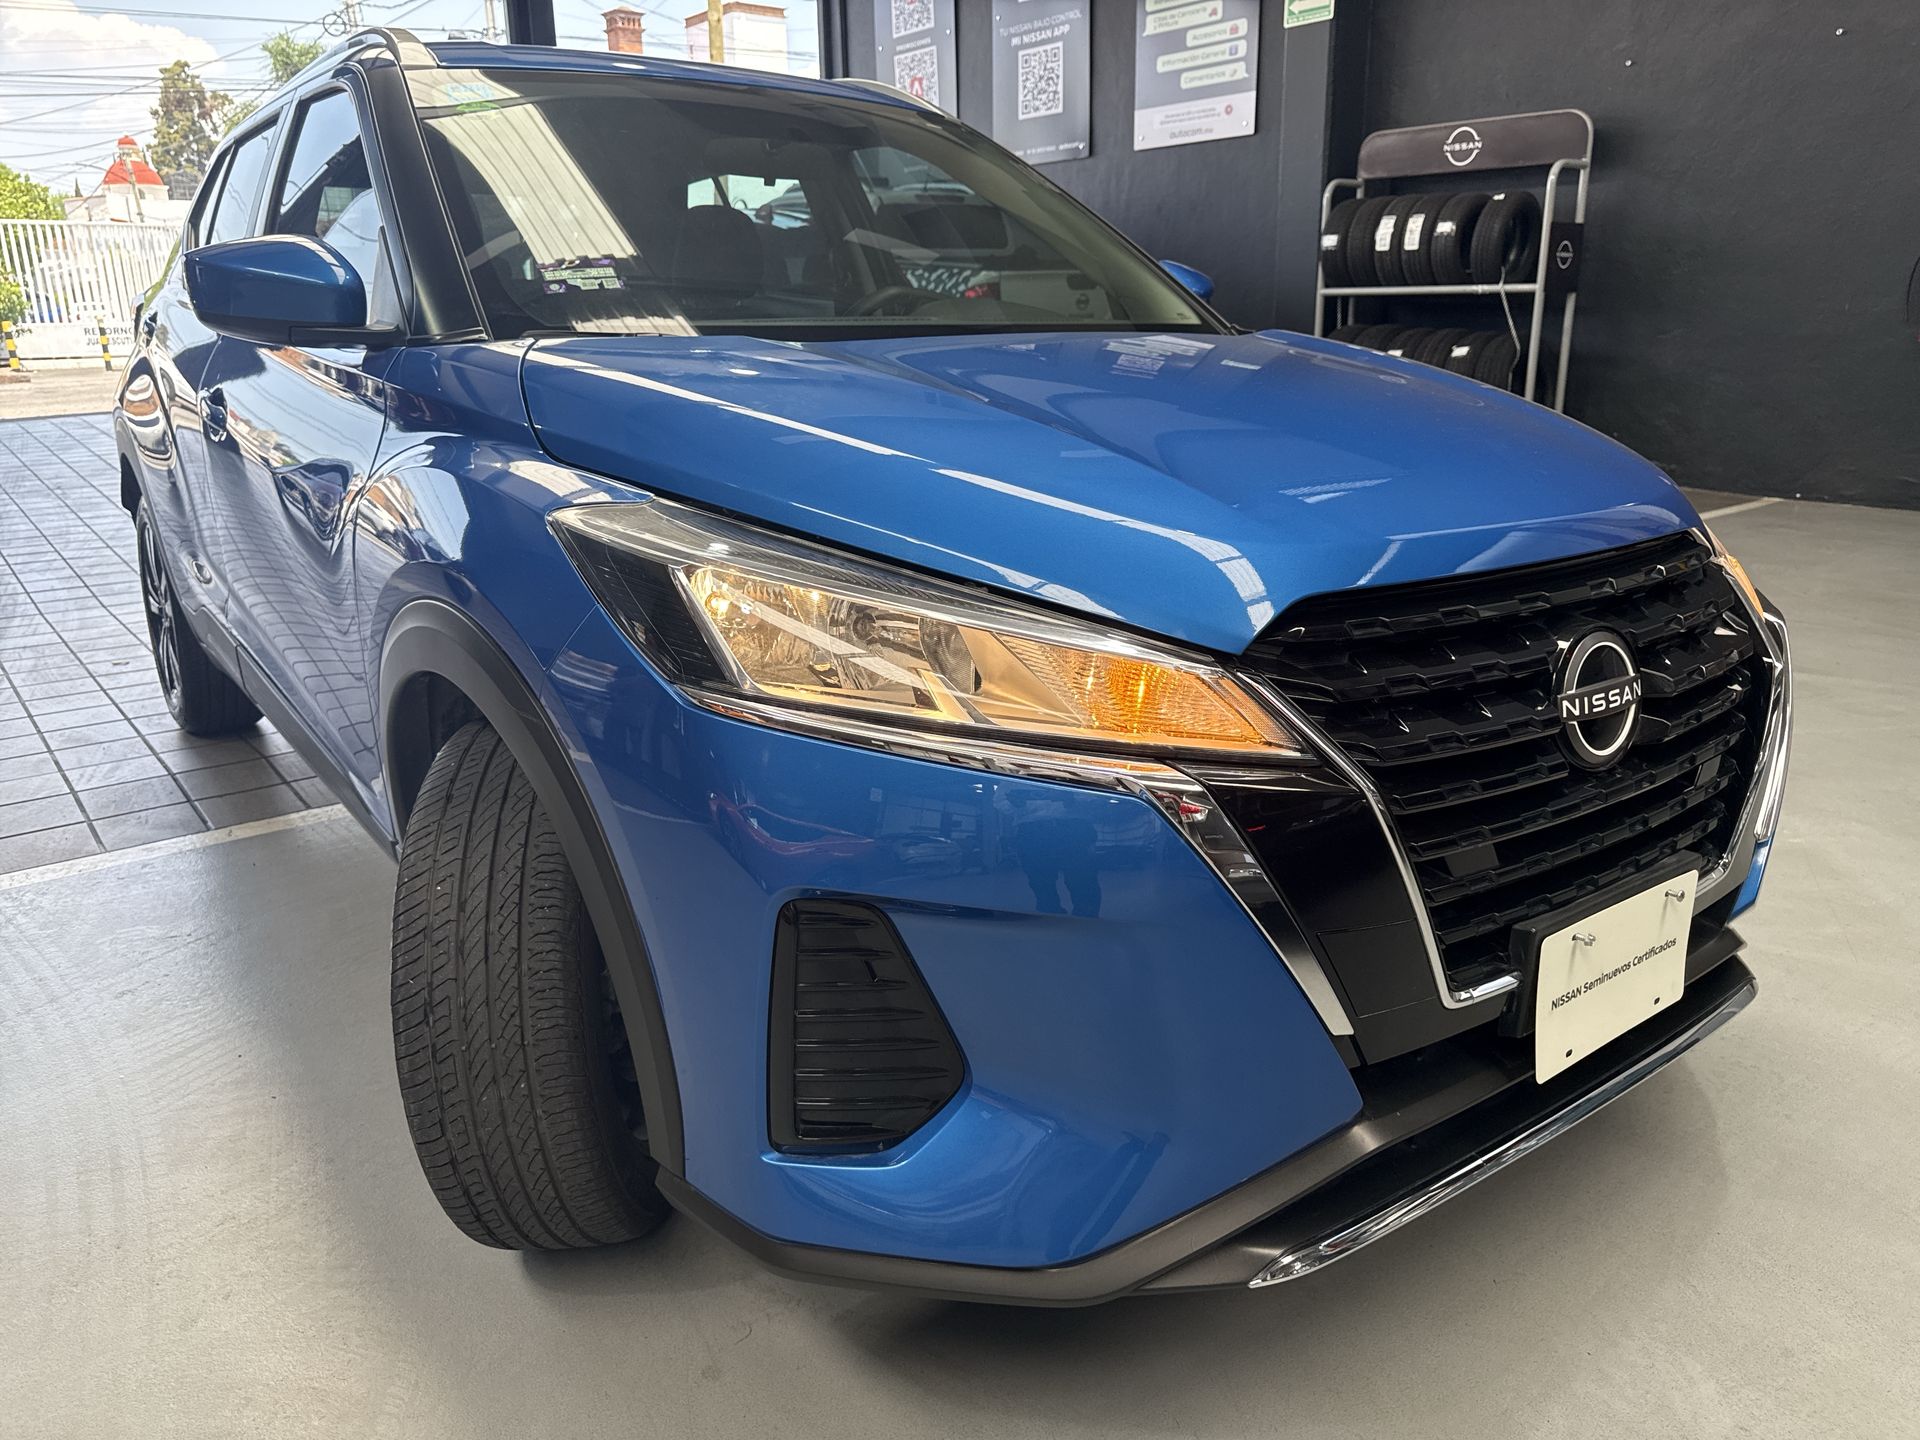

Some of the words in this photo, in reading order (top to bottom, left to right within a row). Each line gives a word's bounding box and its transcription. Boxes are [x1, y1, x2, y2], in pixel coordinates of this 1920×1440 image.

[1011, 36, 1021, 47] MI
[1022, 29, 1052, 44] NISSAN
[1053, 24, 1070, 37] APP
[1443, 141, 1482, 151] NISSAN
[1562, 679, 1641, 718] NISSAN
[1551, 985, 1582, 1011] NISSAN
[1583, 960, 1631, 994] Seminuevos
[1632, 937, 1677, 967] Certificados
